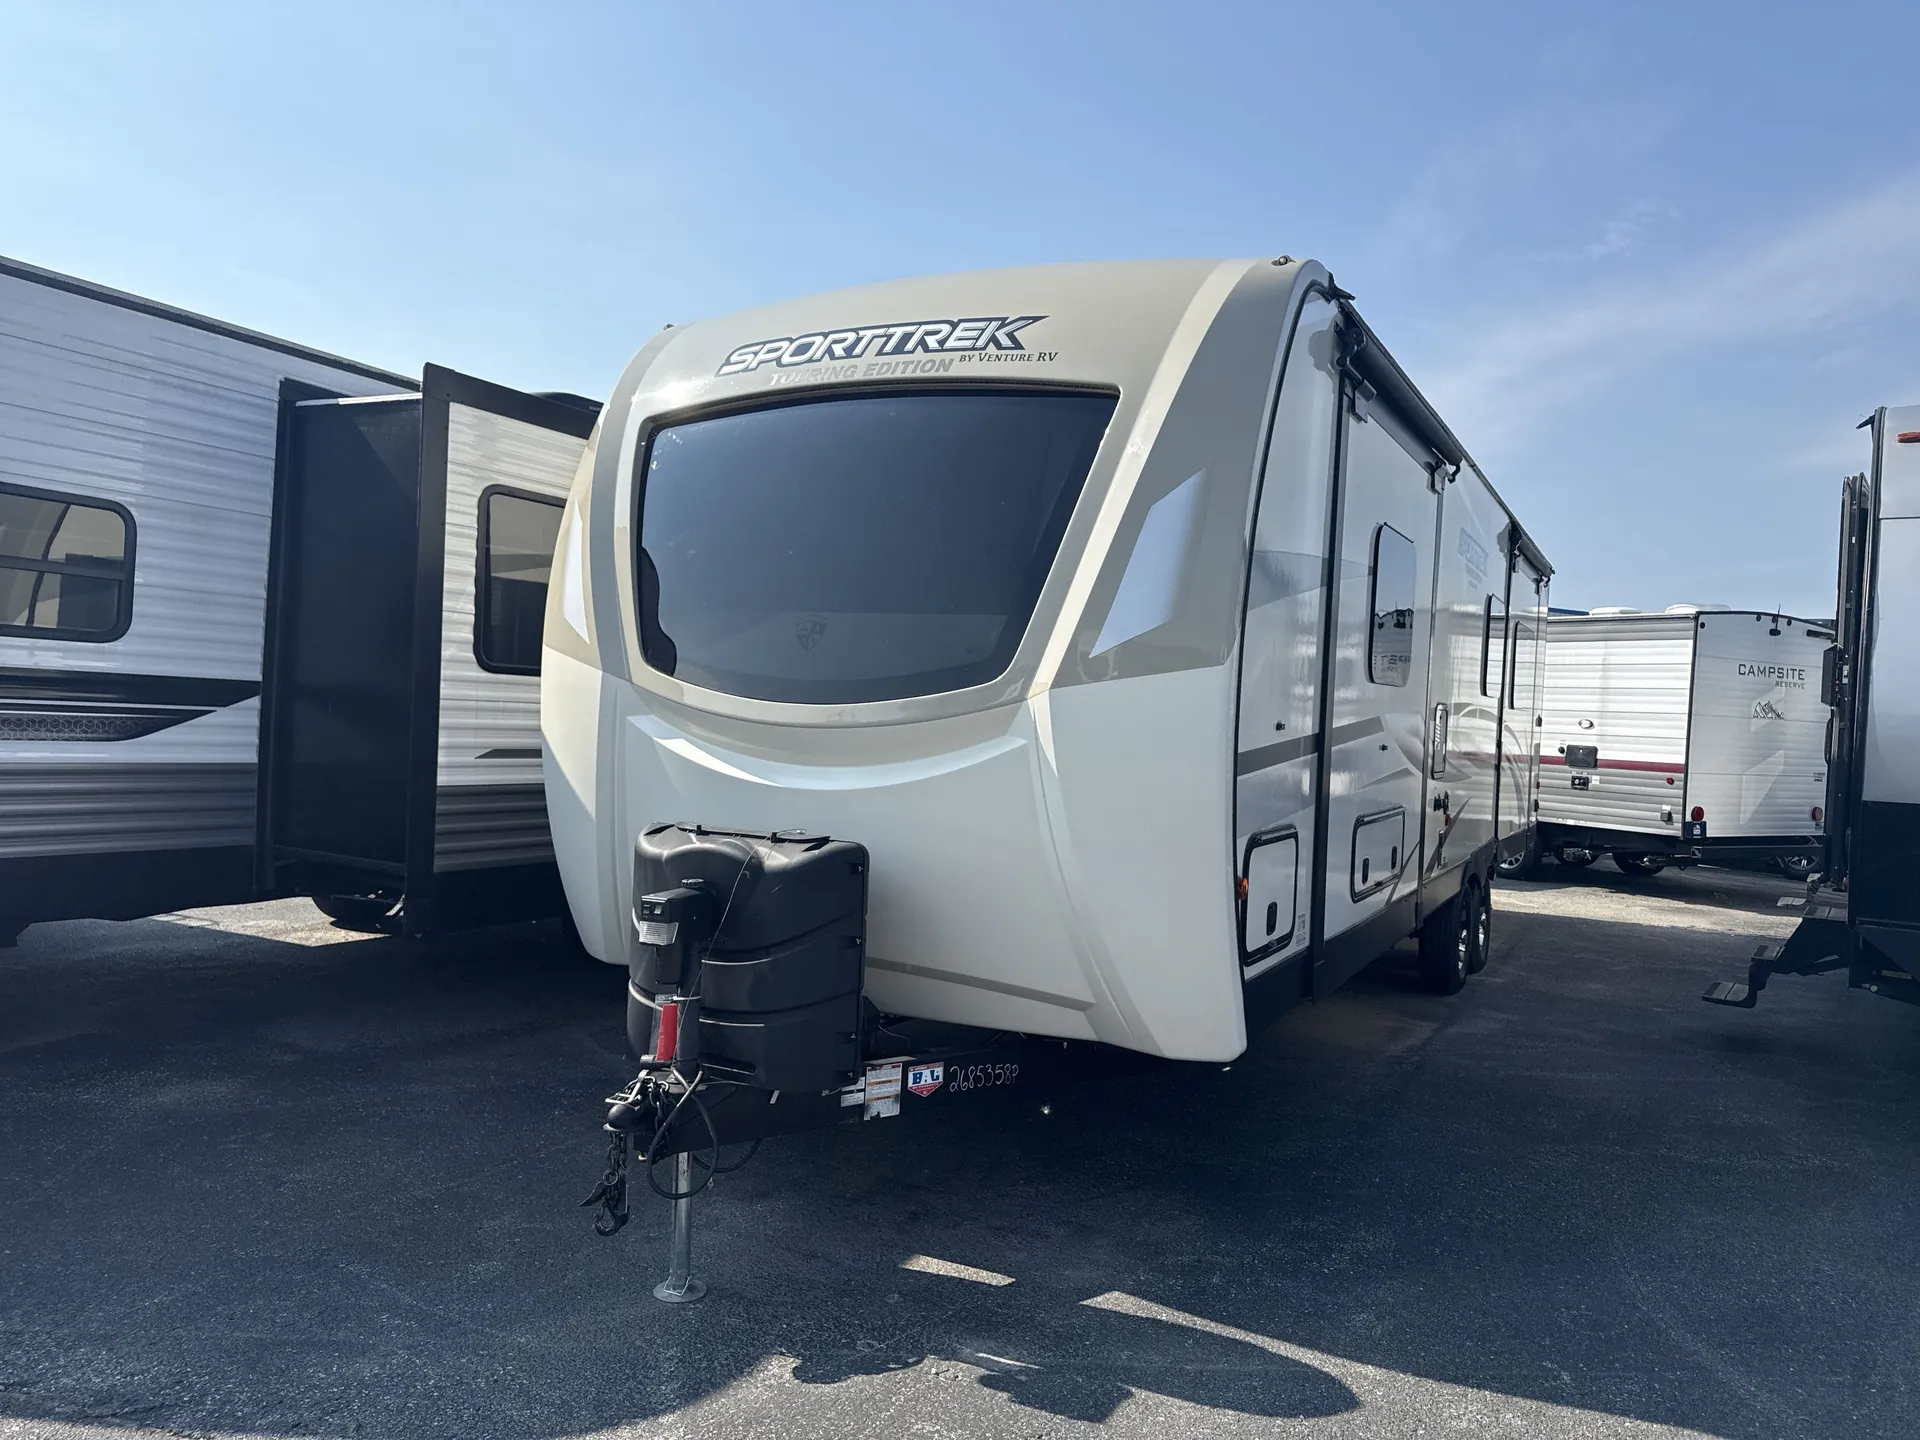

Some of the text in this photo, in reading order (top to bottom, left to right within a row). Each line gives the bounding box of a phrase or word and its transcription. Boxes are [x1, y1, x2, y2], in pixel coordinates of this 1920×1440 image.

[716, 316, 1048, 376] SPORTTREK
[959, 352, 1059, 362] BY VENTURE RV
[769, 358, 954, 385] TOURING EDITION
[1738, 663, 1805, 680] CAMPSITE
[1775, 680, 1805, 689] RESERVE
